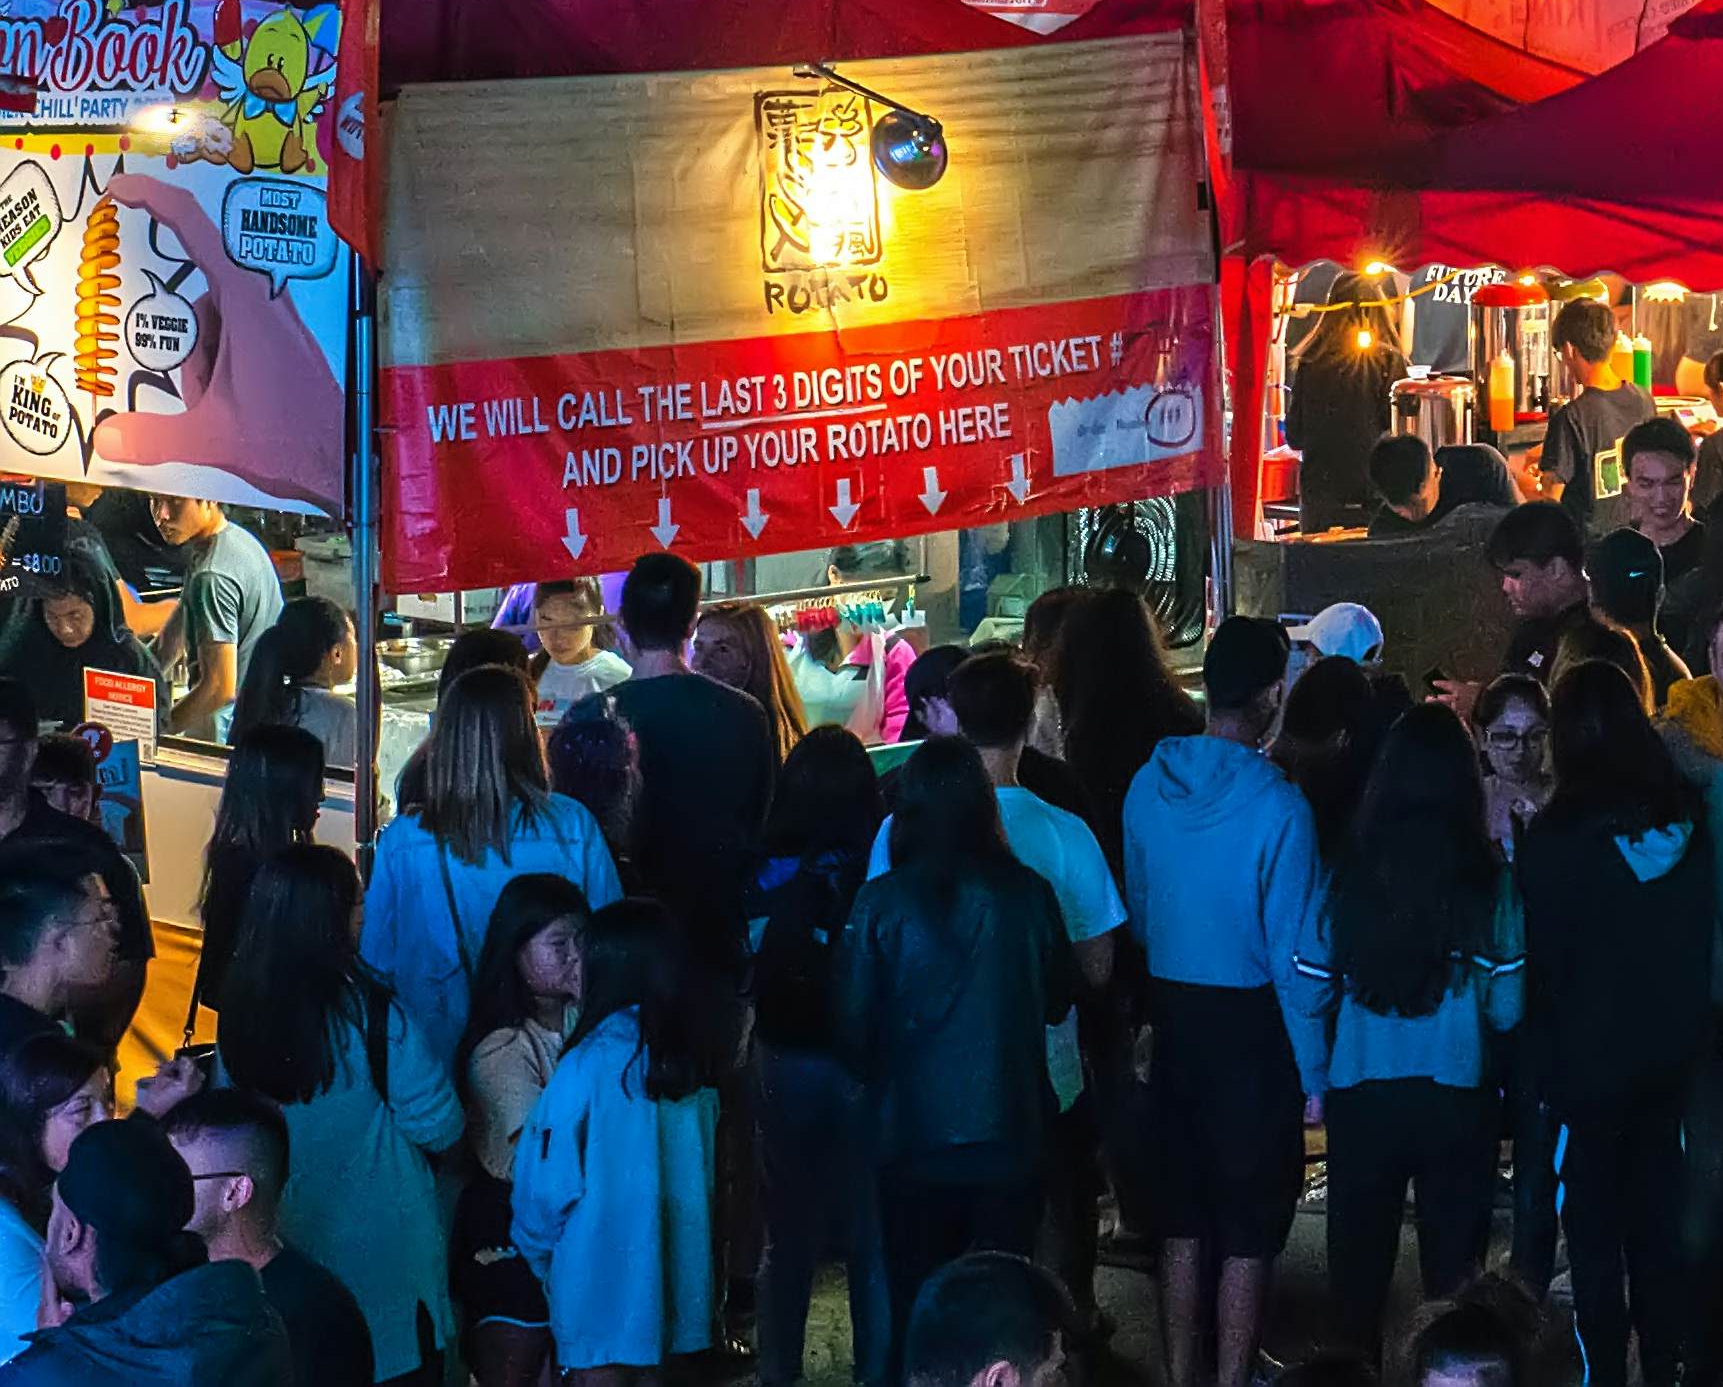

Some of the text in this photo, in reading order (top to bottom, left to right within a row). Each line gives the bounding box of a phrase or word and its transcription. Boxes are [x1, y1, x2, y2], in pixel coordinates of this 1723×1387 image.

[79, 94, 128, 118] PARTY
[260, 188, 301, 208] MOST
[23, 204, 42, 228] EAT
[240, 208, 319, 239] HANDSOME
[239, 234, 316, 266] POTATO
[764, 273, 888, 315] ROTATO
[135, 312, 149, 329] 1%
[159, 335, 181, 352] FUN
[11, 386, 53, 417] KING
[426, 331, 1124, 444] WE WILL CALL THE LAST 3 DIGITS OF YOUR TICKET #
[8, 408, 59, 440] POTATO
[561, 402, 1014, 491] AND PICK UP YOUR ROTATO HERE
